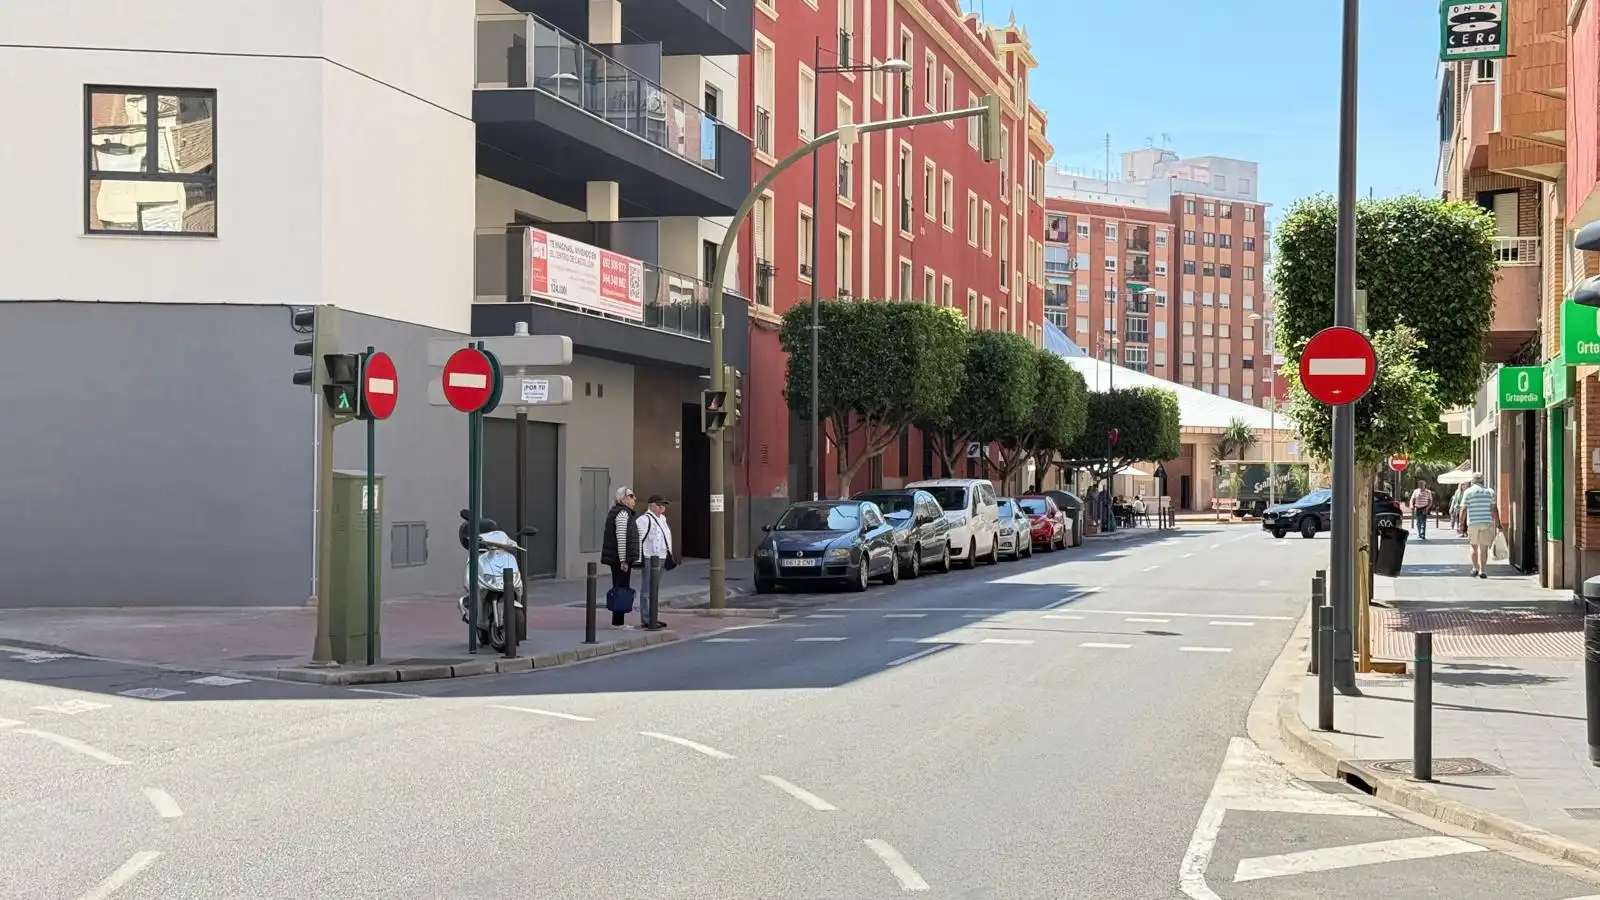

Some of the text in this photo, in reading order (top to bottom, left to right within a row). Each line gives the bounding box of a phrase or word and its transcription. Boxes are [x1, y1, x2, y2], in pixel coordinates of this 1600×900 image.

[1453, 4, 1496, 13] ONDA
[1449, 33, 1496, 45] CERO
[1506, 393, 1538, 402] Ortopedia
